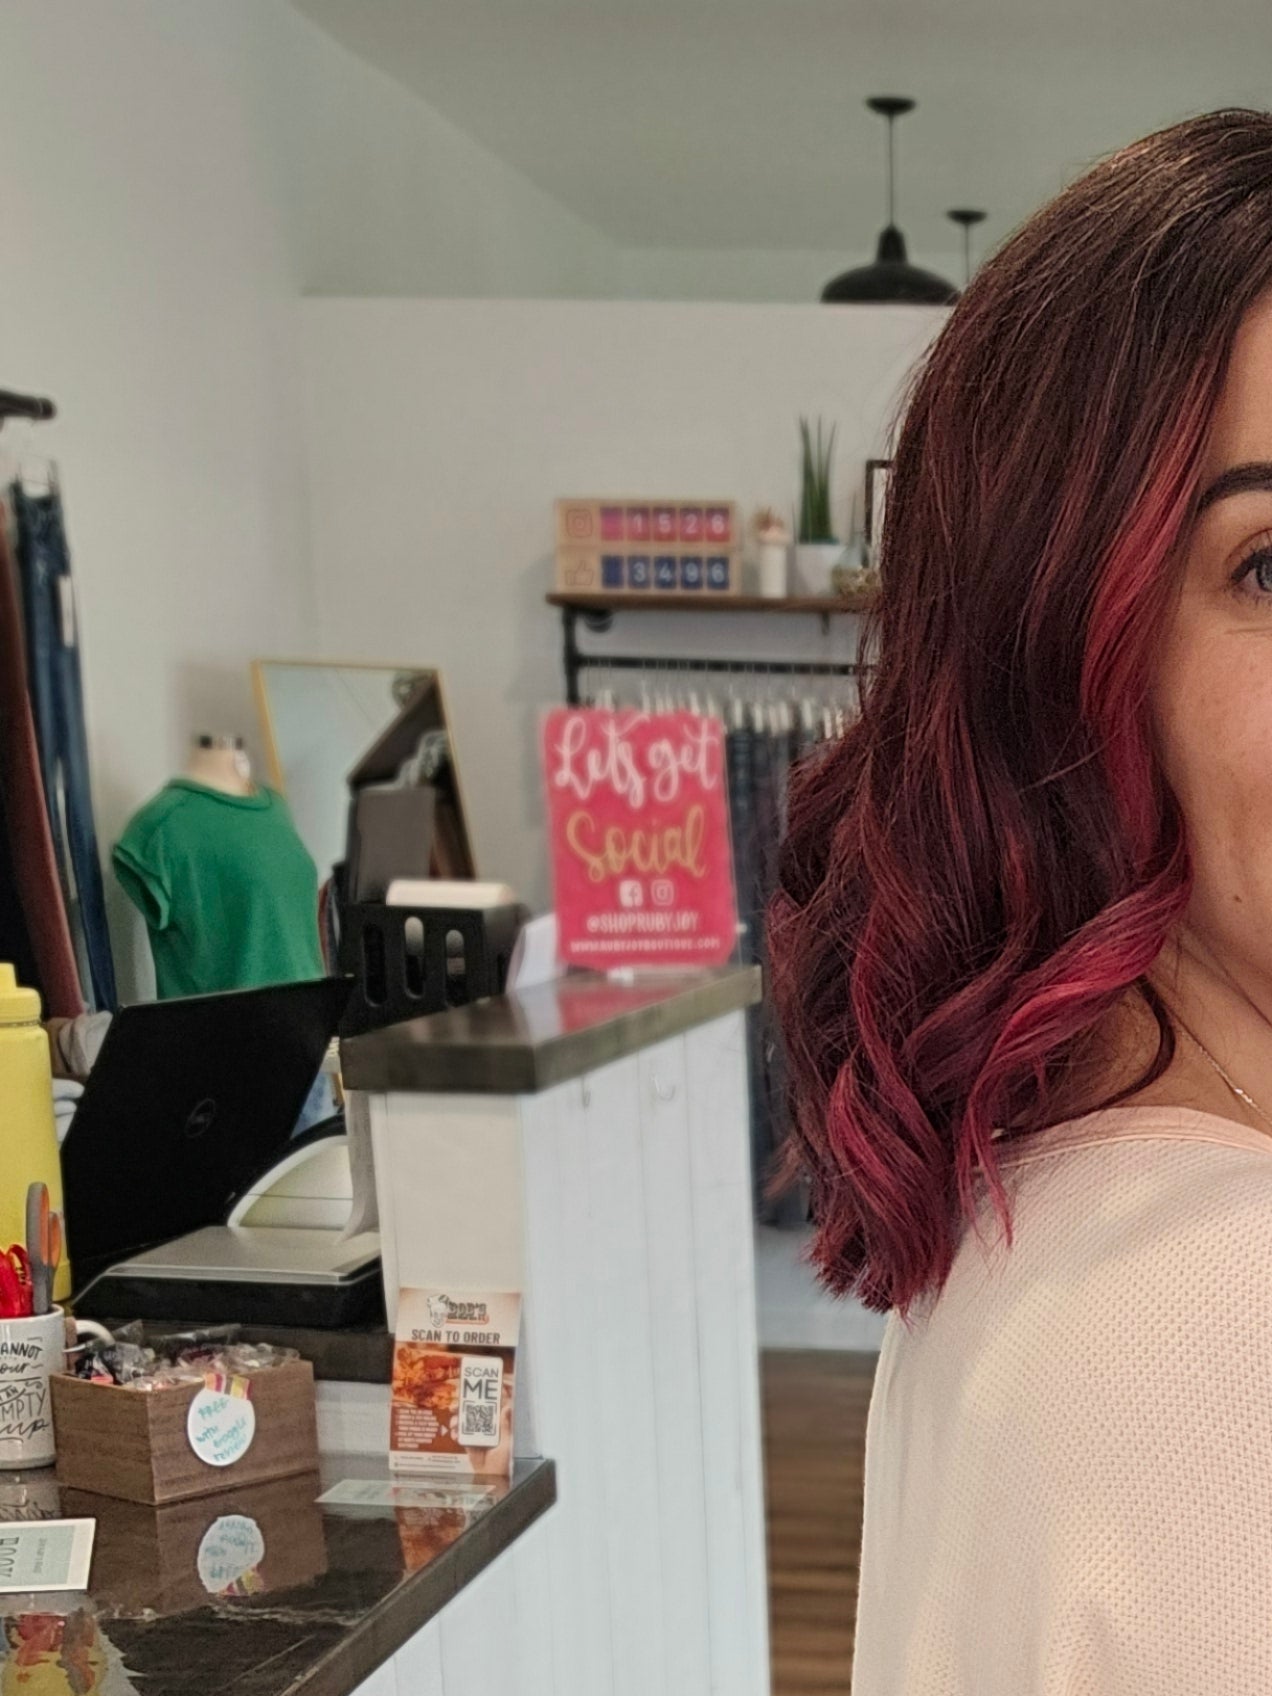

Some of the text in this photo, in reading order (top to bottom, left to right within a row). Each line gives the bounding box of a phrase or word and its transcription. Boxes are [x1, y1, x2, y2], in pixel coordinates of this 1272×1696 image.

[633, 513, 725, 535] 1526
[633, 562, 725, 583] 3496
[648, 719, 721, 803] get
[566, 804, 707, 884] Social
[411, 1329, 501, 1345] SCAN TO ORDER
[0, 1342, 43, 1360] ANNOT
[463, 1366, 499, 1378] SCAN
[462, 1378, 499, 1400] ME
[0, 1388, 46, 1422] MPTY
